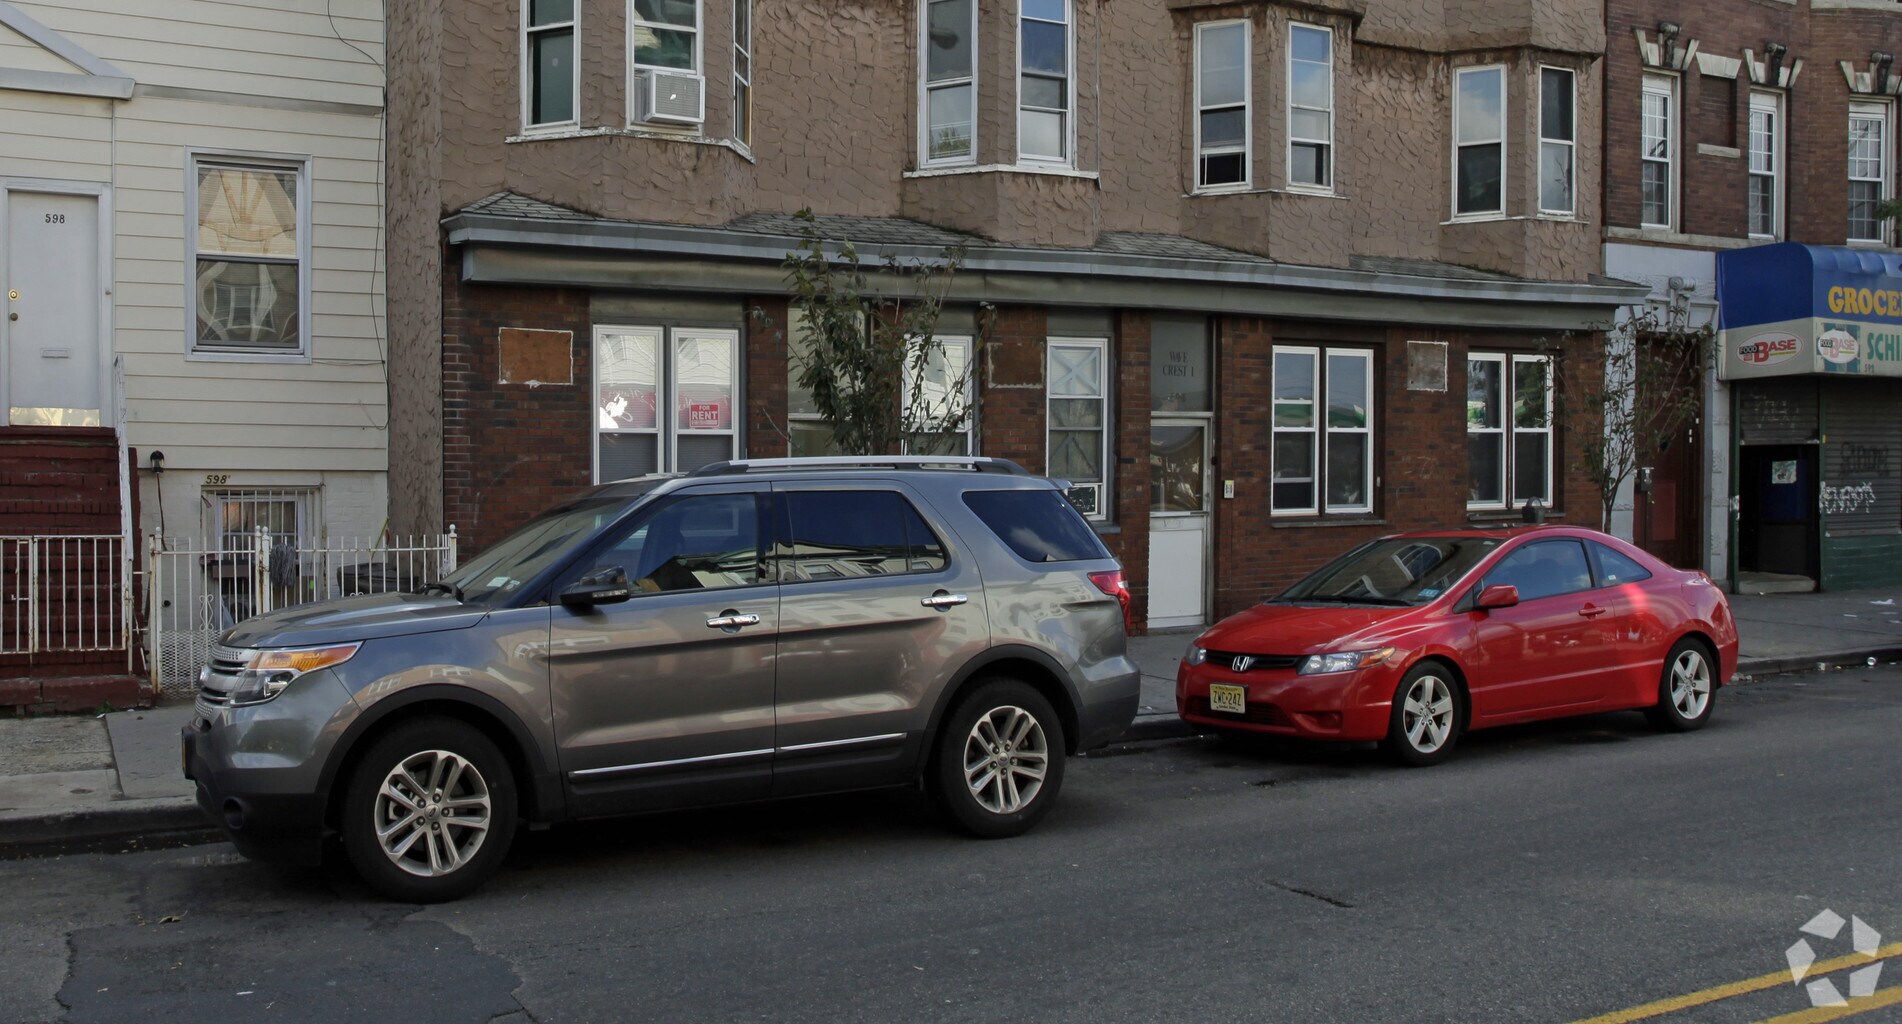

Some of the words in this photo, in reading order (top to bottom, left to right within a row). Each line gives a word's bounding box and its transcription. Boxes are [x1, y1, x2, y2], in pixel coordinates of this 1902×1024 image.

[45, 213, 65, 224] 598
[1828, 285, 1902, 317] GROCE
[1740, 345, 1758, 354] FOOD
[1754, 339, 1797, 363] BASE
[1867, 332, 1902, 361] SCHI
[1162, 365, 1187, 377] CREST
[691, 411, 718, 420] RENT
[205, 474, 227, 485] 598
